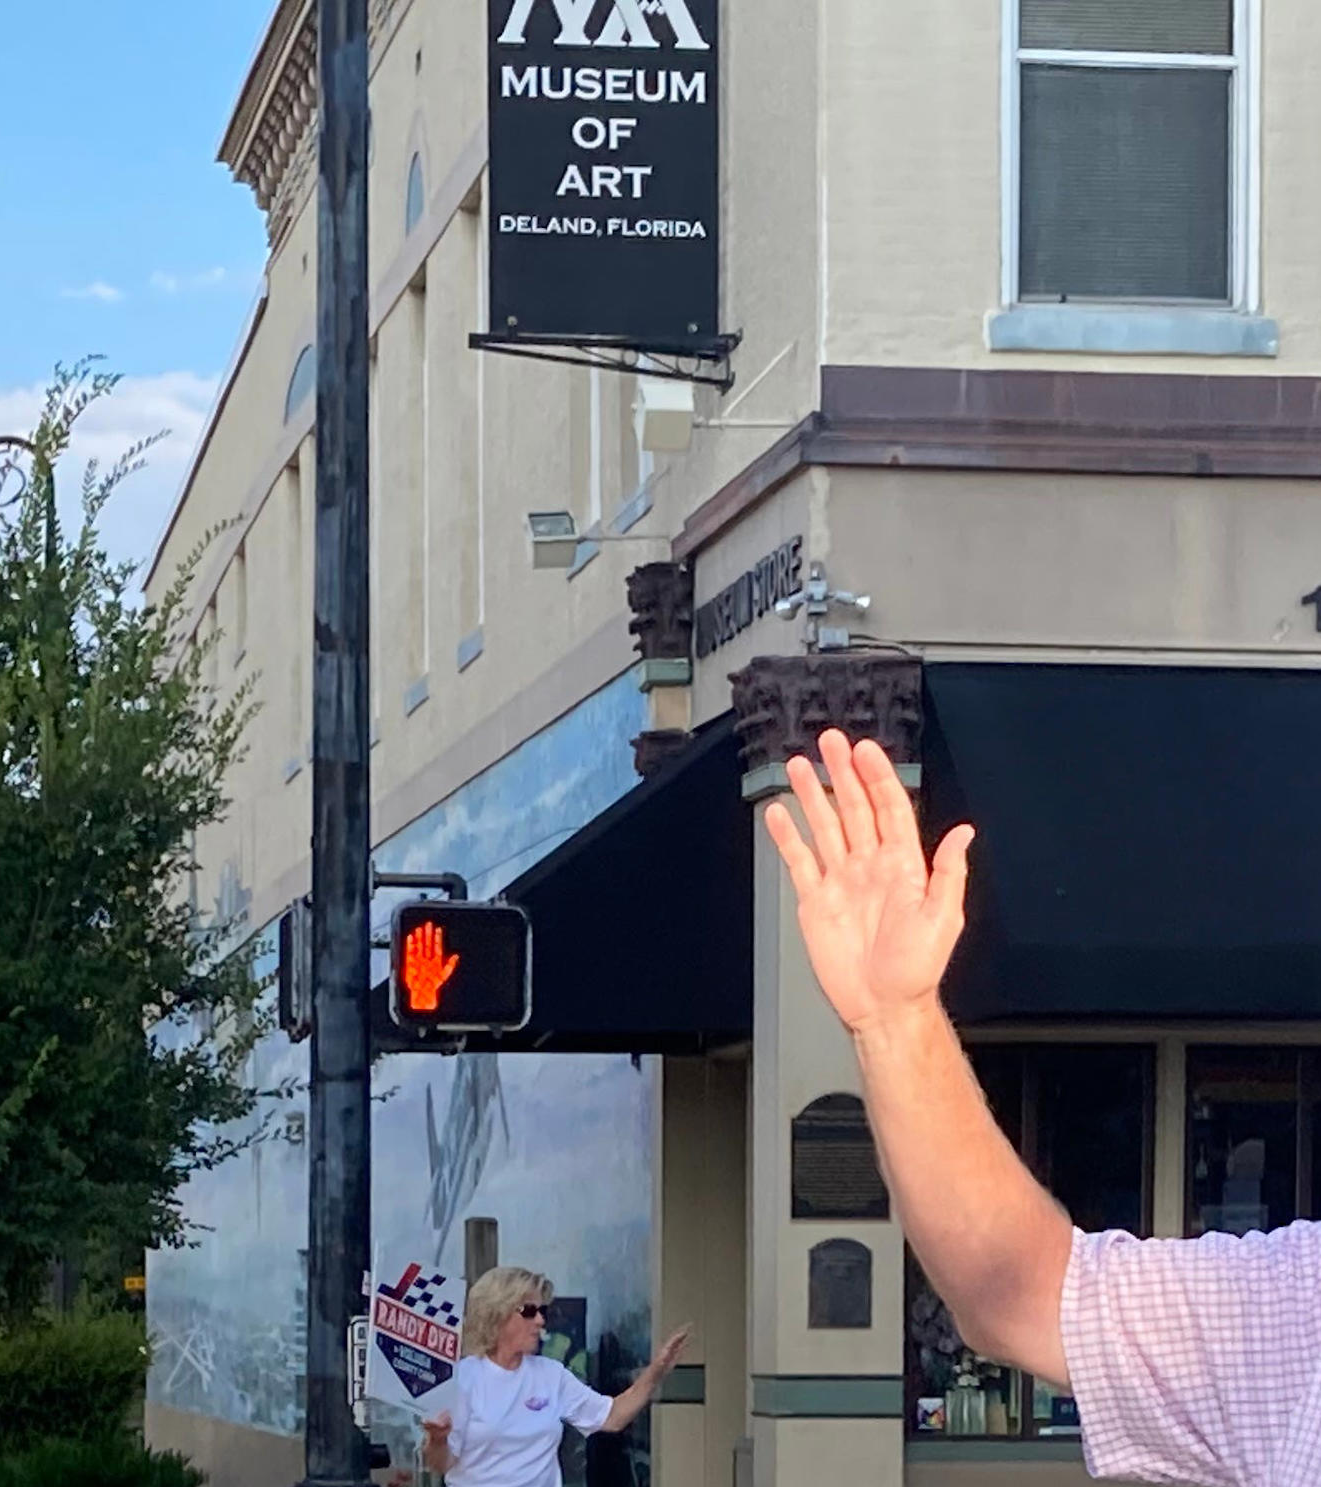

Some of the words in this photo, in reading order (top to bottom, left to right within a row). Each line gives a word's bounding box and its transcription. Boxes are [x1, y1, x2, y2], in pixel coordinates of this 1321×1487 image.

[500, 65, 707, 104] MUSEUM
[571, 116, 638, 150] OF
[555, 164, 654, 199] ART
[498, 214, 603, 238] DELAND,
[606, 217, 707, 239] FLORIDA
[377, 1300, 428, 1344] RANDY
[427, 1324, 456, 1358] DYE
